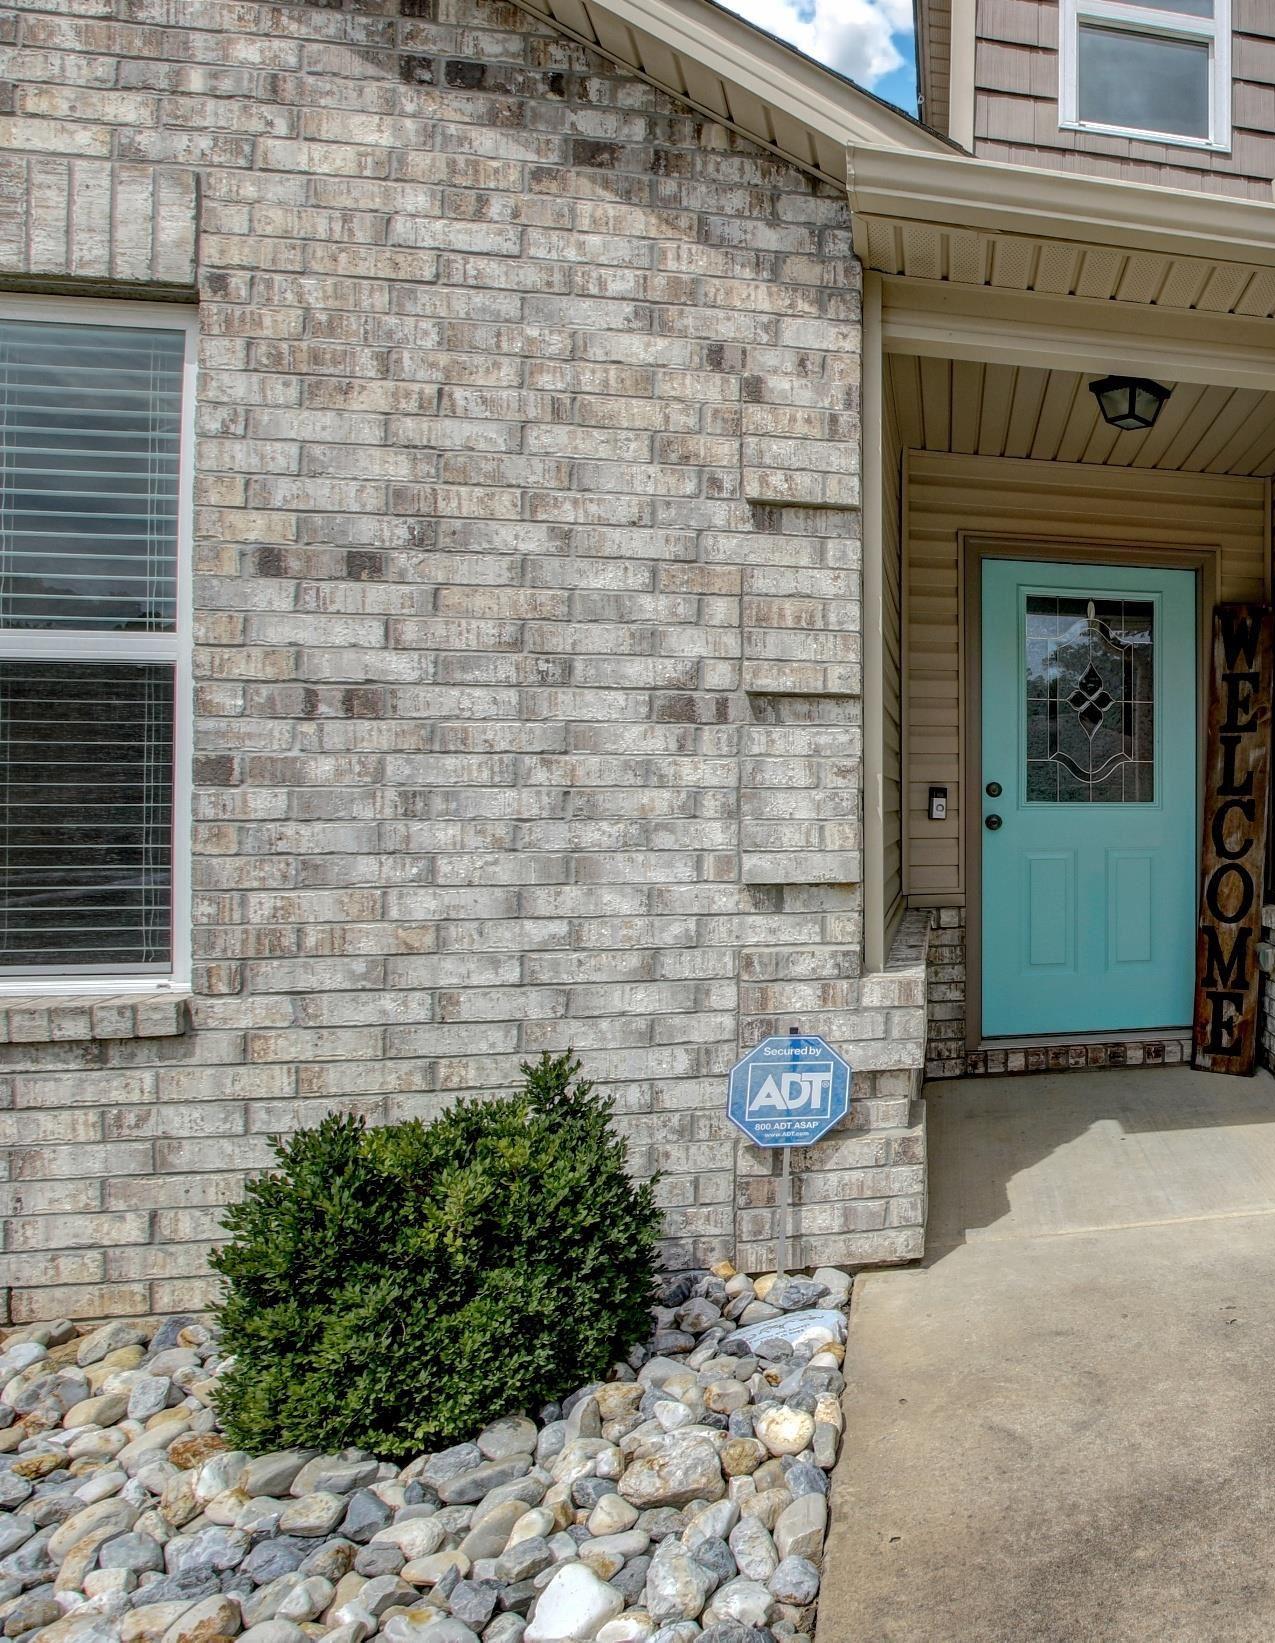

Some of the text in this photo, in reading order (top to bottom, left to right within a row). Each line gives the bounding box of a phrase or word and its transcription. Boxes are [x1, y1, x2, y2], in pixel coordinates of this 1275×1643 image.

[1200, 607, 1265, 1056] WELCOME
[763, 1046, 822, 1057] Secured by
